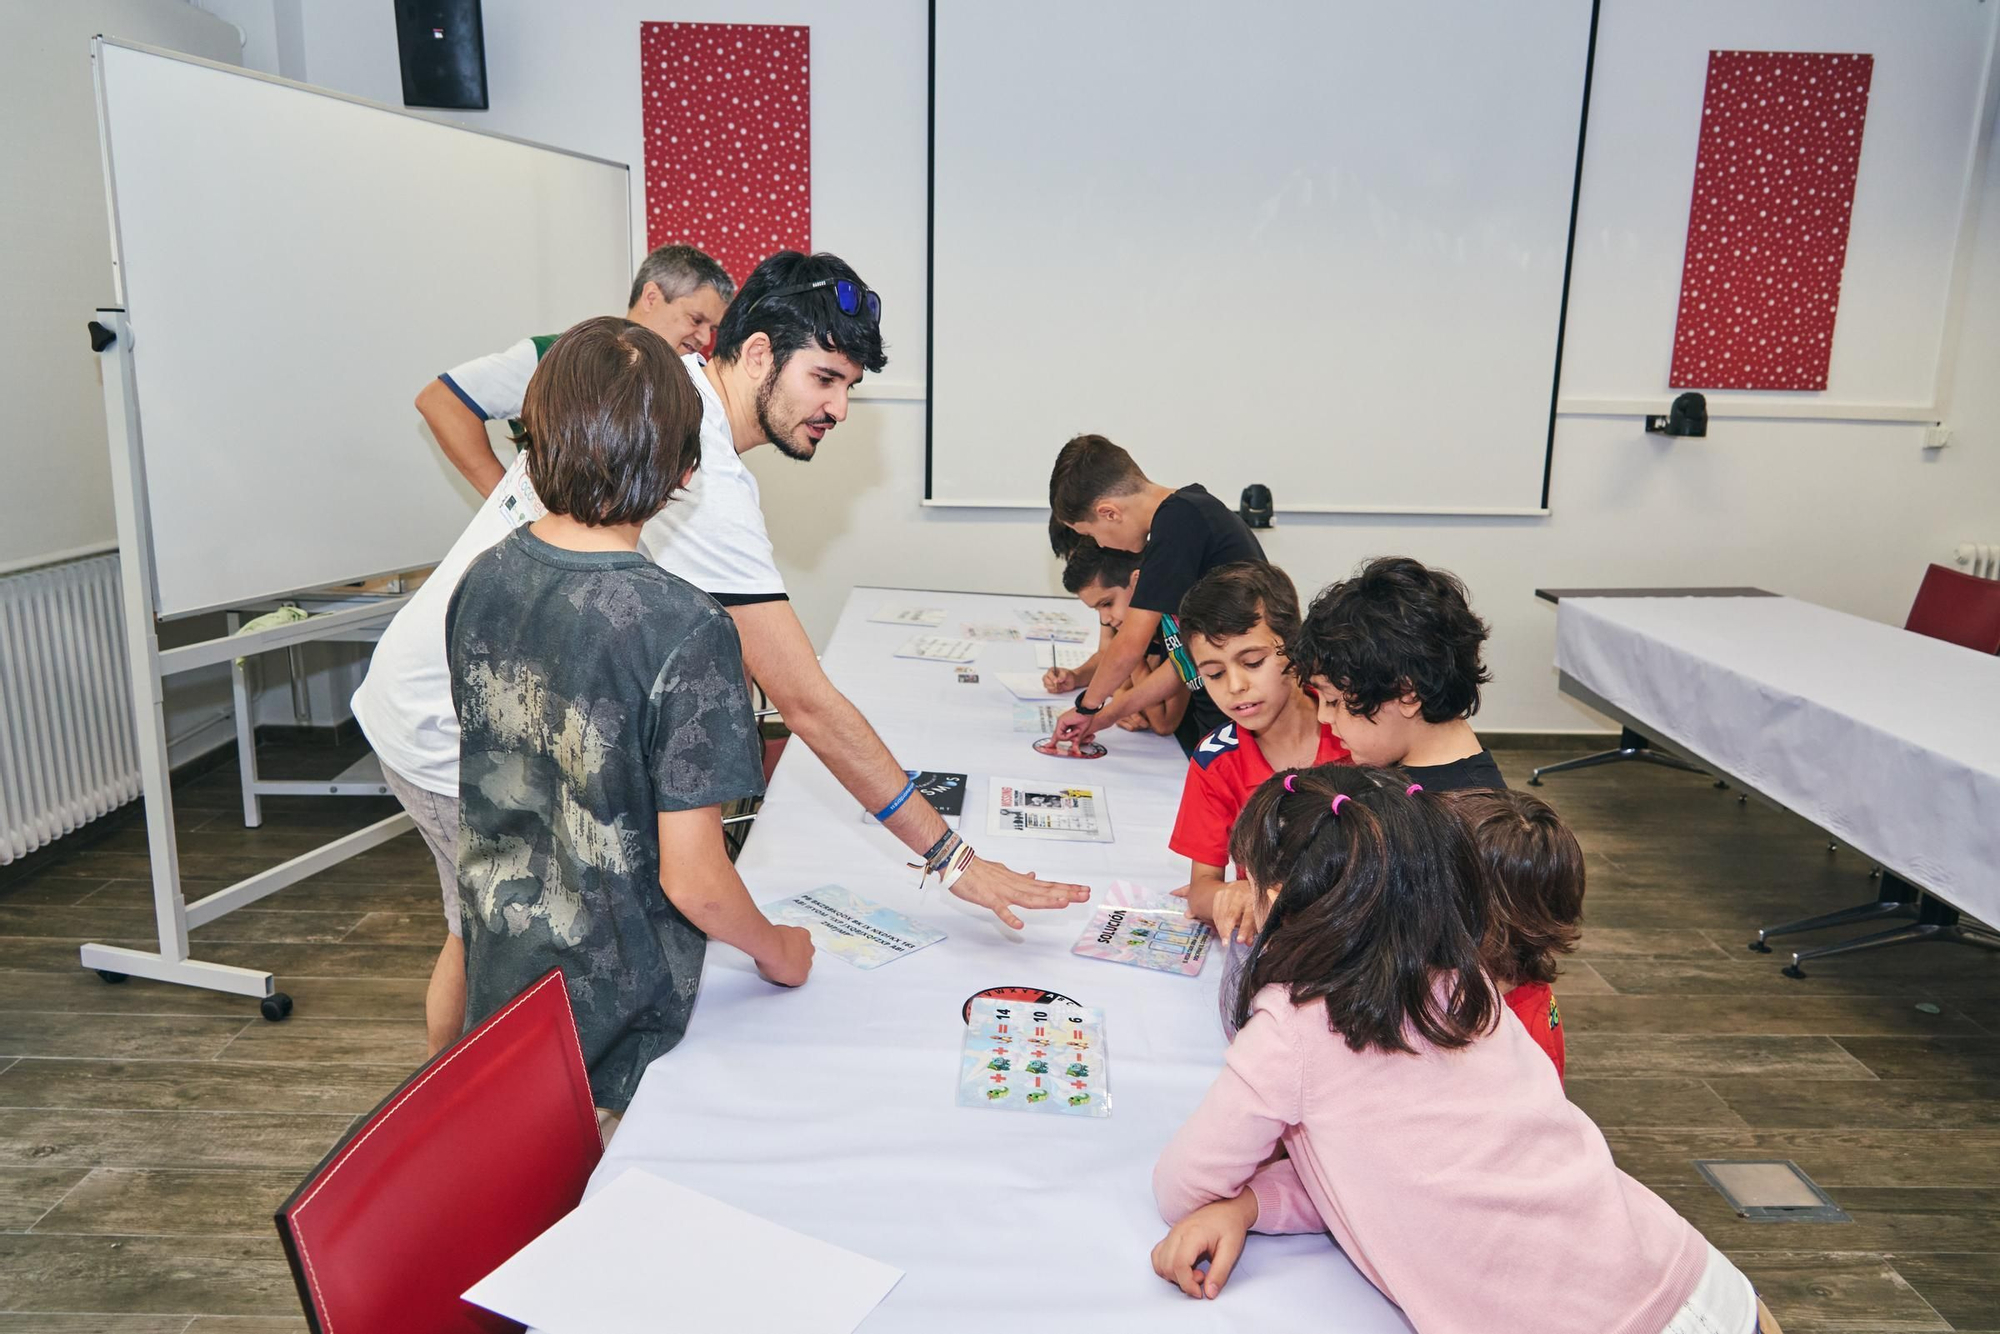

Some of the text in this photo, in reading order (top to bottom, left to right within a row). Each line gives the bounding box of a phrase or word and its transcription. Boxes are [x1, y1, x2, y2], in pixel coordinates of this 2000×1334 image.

[1097, 910, 1127, 944] SOLUCIÓN
[996, 1008, 1010, 1020] 14
[1033, 1011, 1048, 1022] 10
